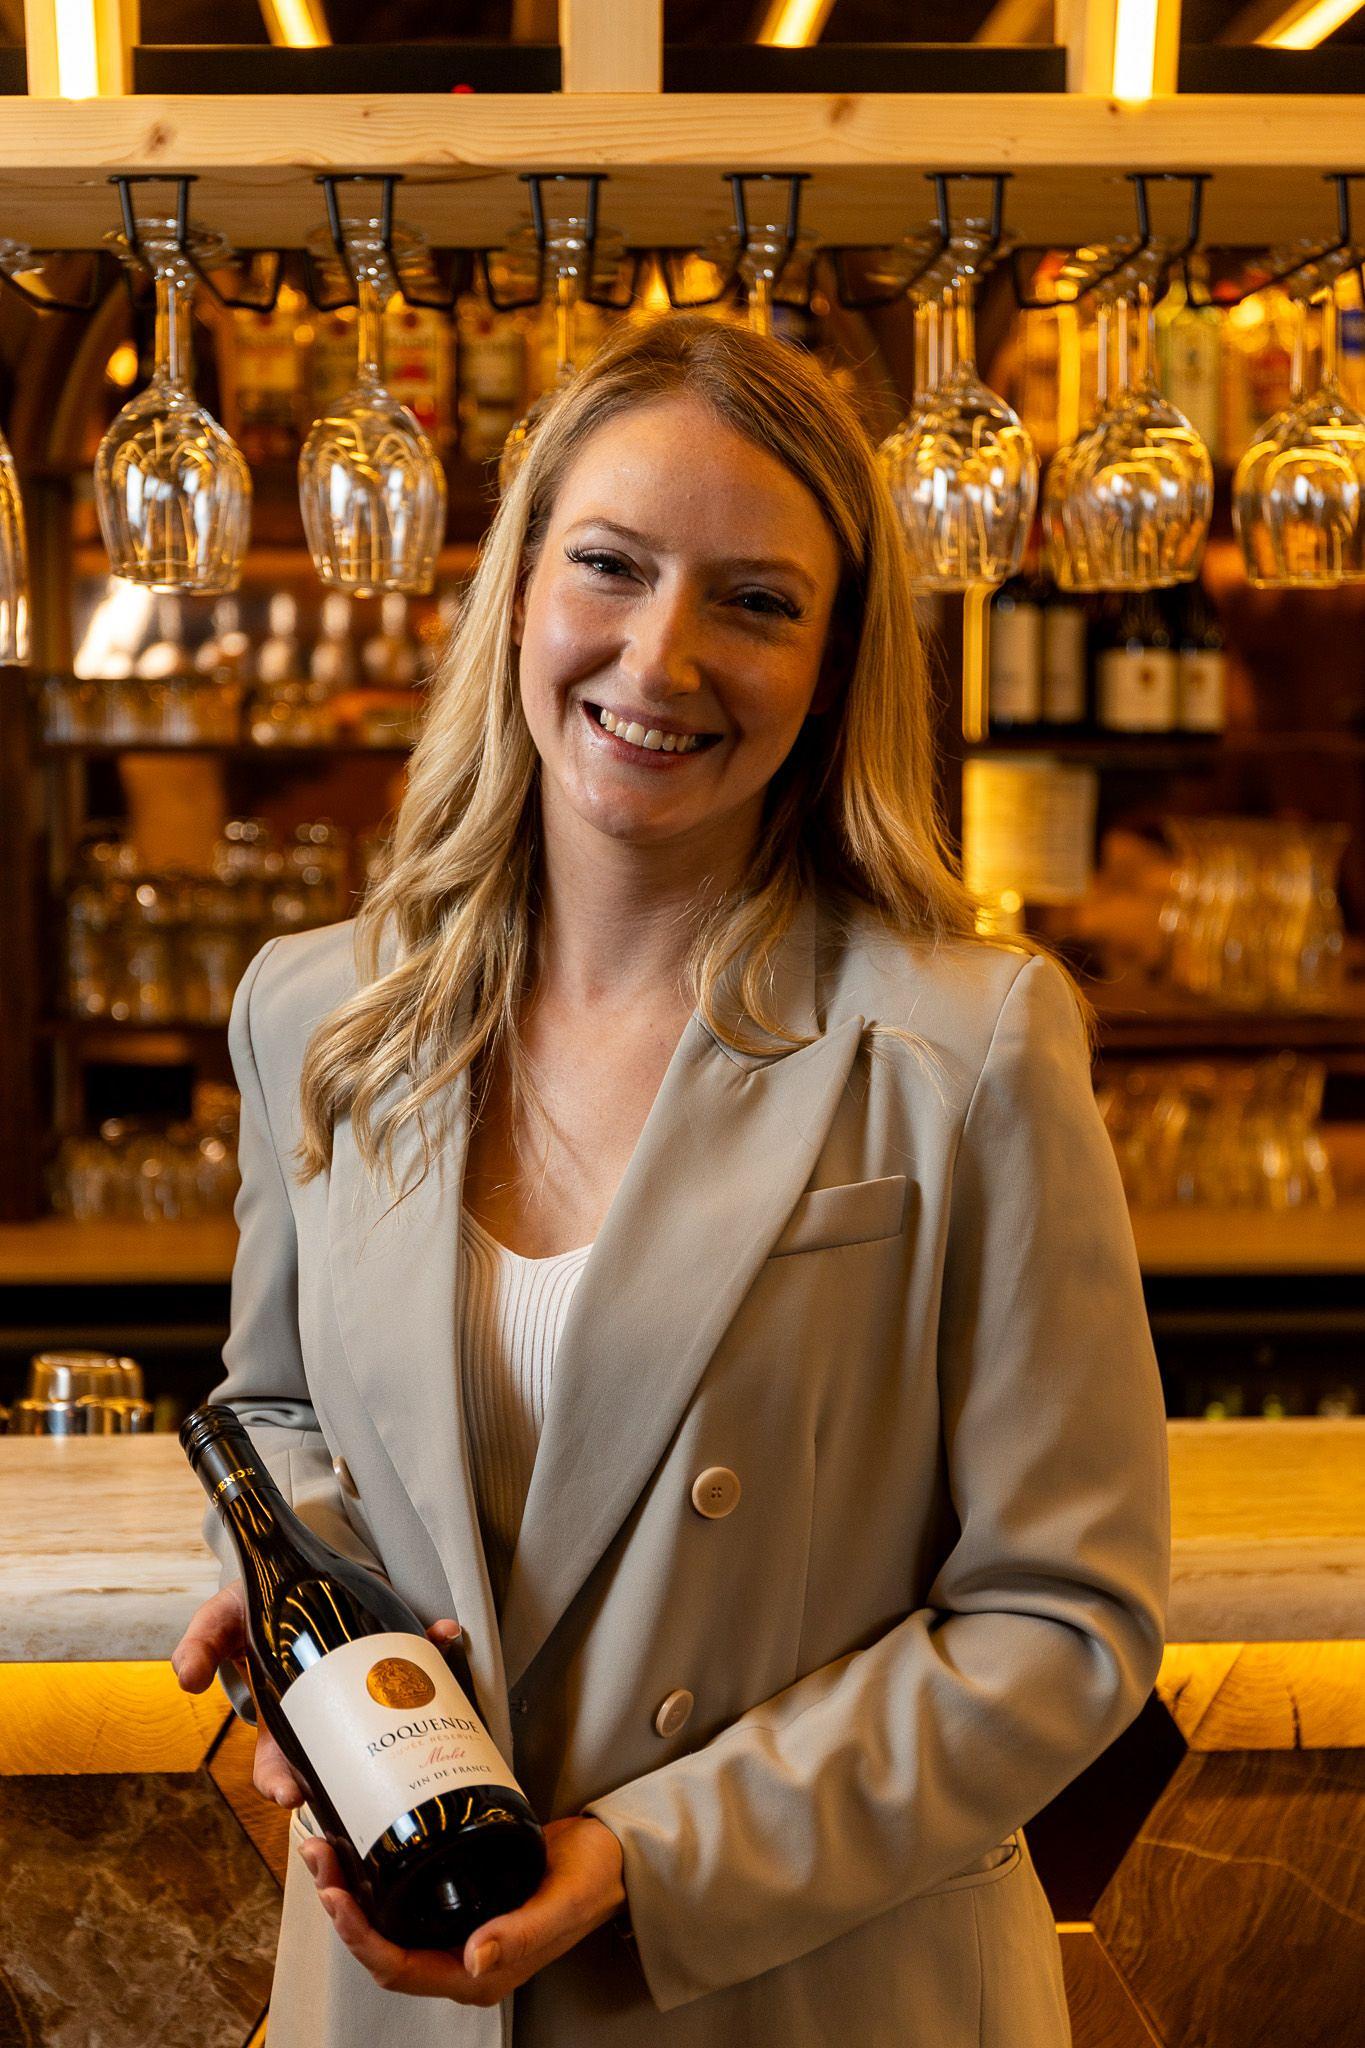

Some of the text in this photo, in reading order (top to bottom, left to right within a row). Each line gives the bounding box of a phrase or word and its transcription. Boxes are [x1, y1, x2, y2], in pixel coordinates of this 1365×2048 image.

[367, 1717, 480, 1757] ROQUENDE
[419, 1746, 465, 1768] Merlot
[409, 1765, 492, 1790] VIN DE FRANCE
